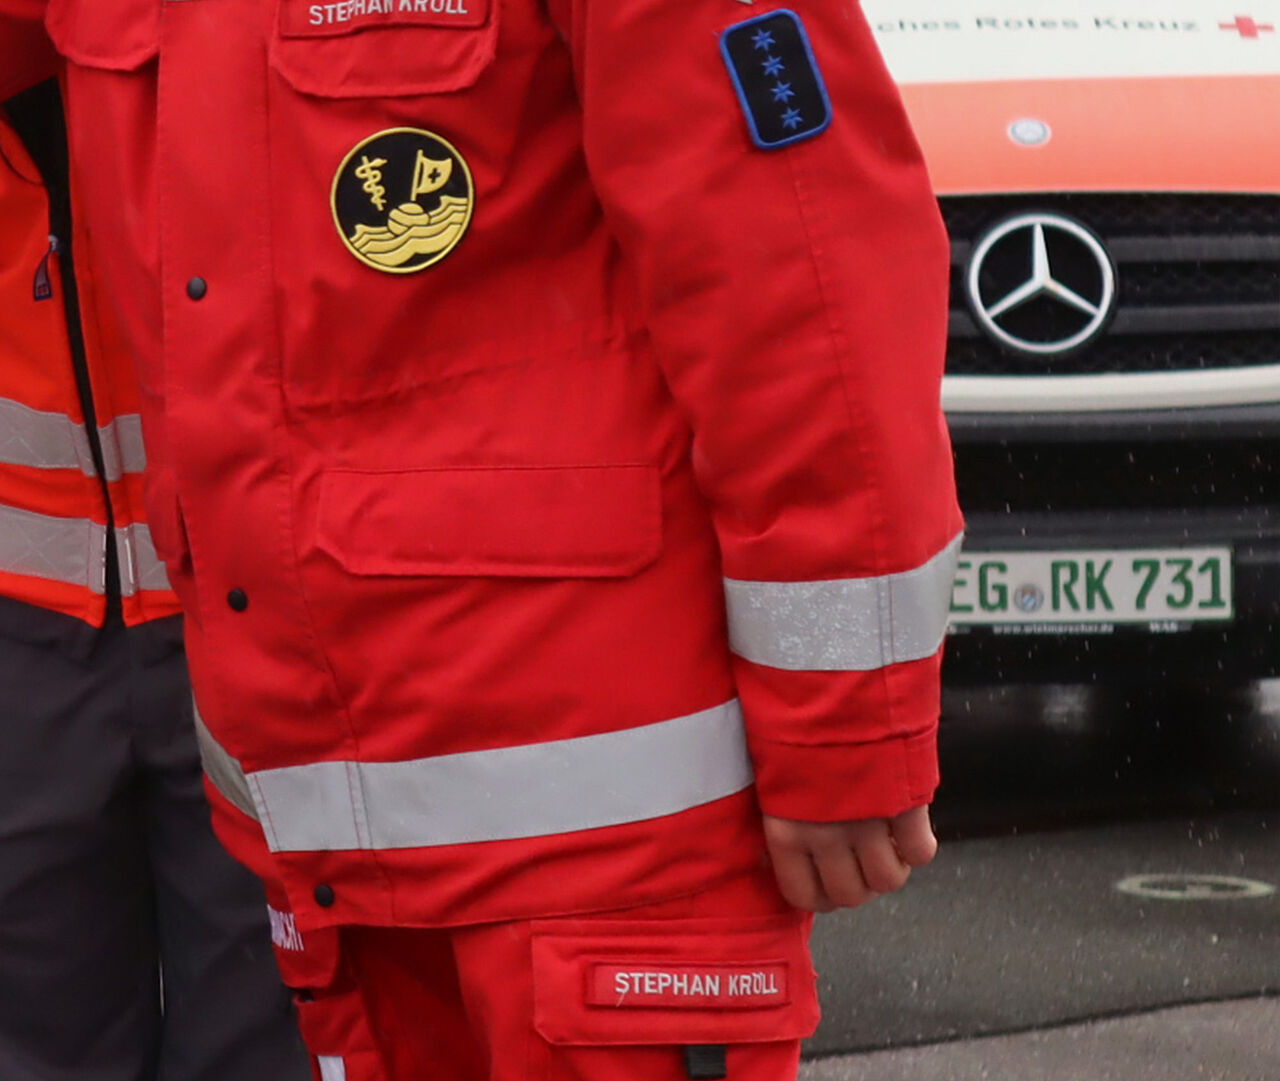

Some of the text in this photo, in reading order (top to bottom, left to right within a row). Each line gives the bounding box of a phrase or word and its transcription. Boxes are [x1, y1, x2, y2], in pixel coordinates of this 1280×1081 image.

[976, 17, 1079, 31] Rotes
[1094, 18, 1198, 31] Kreuz
[1051, 560, 1114, 611] RK
[1132, 557, 1226, 610] 731
[615, 972, 780, 997] STEPHAN KRÖLL
